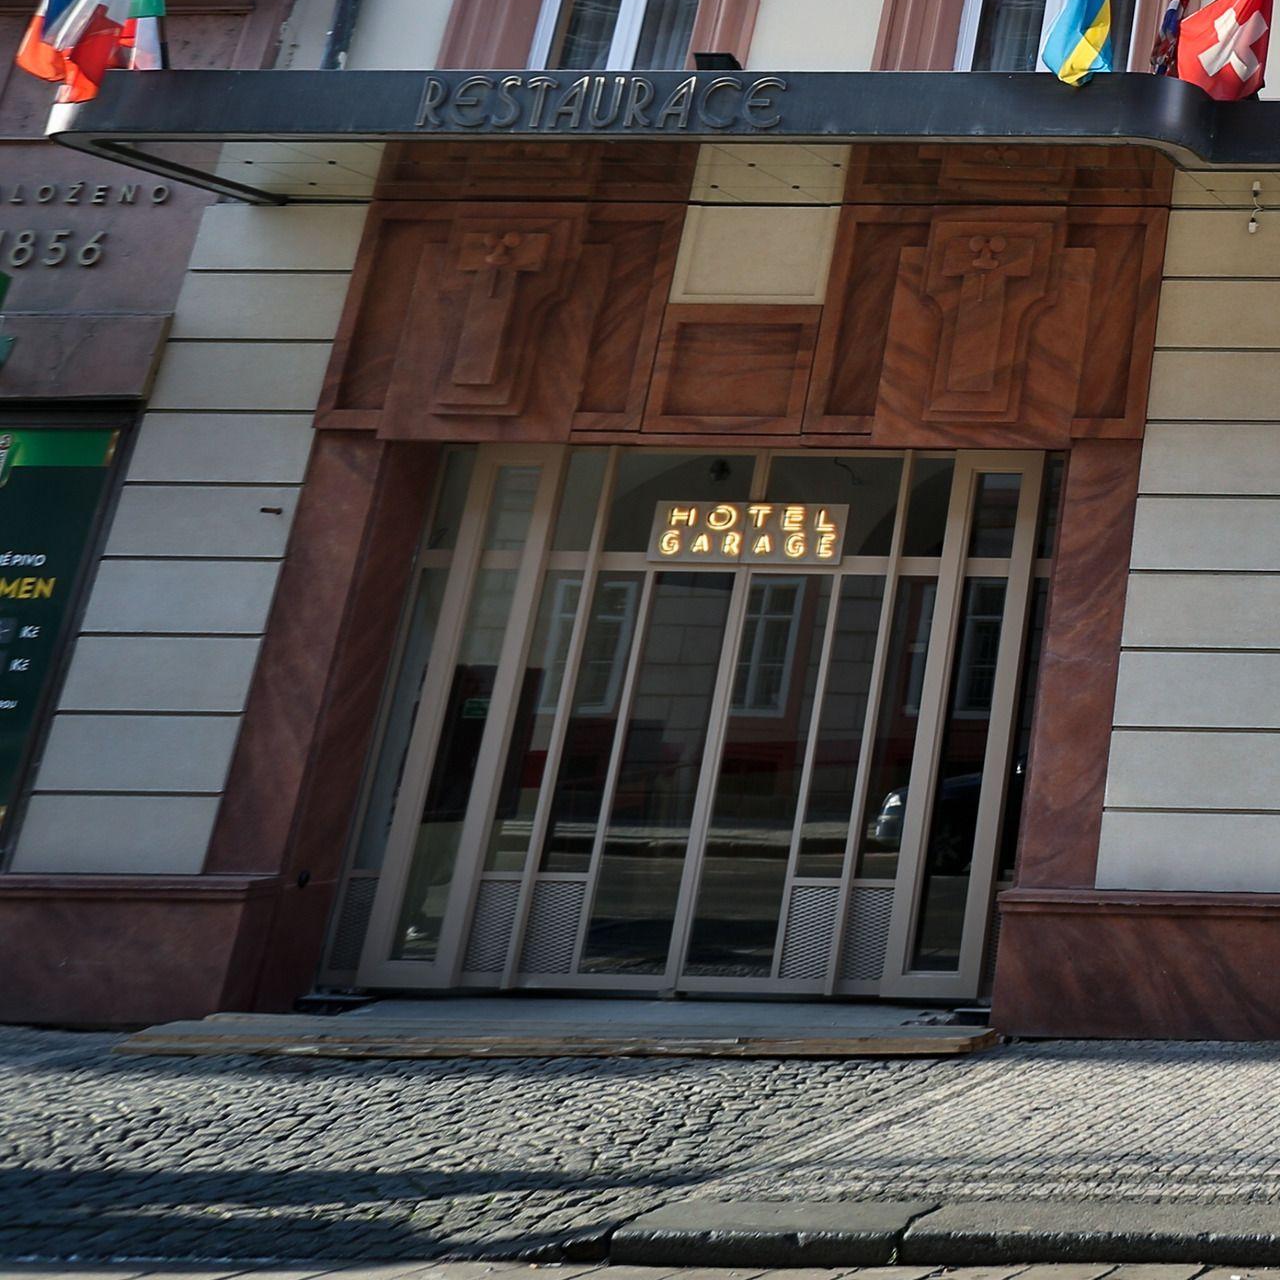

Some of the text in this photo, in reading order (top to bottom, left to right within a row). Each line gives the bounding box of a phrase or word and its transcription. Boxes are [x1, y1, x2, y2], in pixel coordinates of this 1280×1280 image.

[415, 75, 786, 129] RESTAURACE
[670, 505, 835, 532] HOTEL
[659, 530, 836, 558] GARAGE
